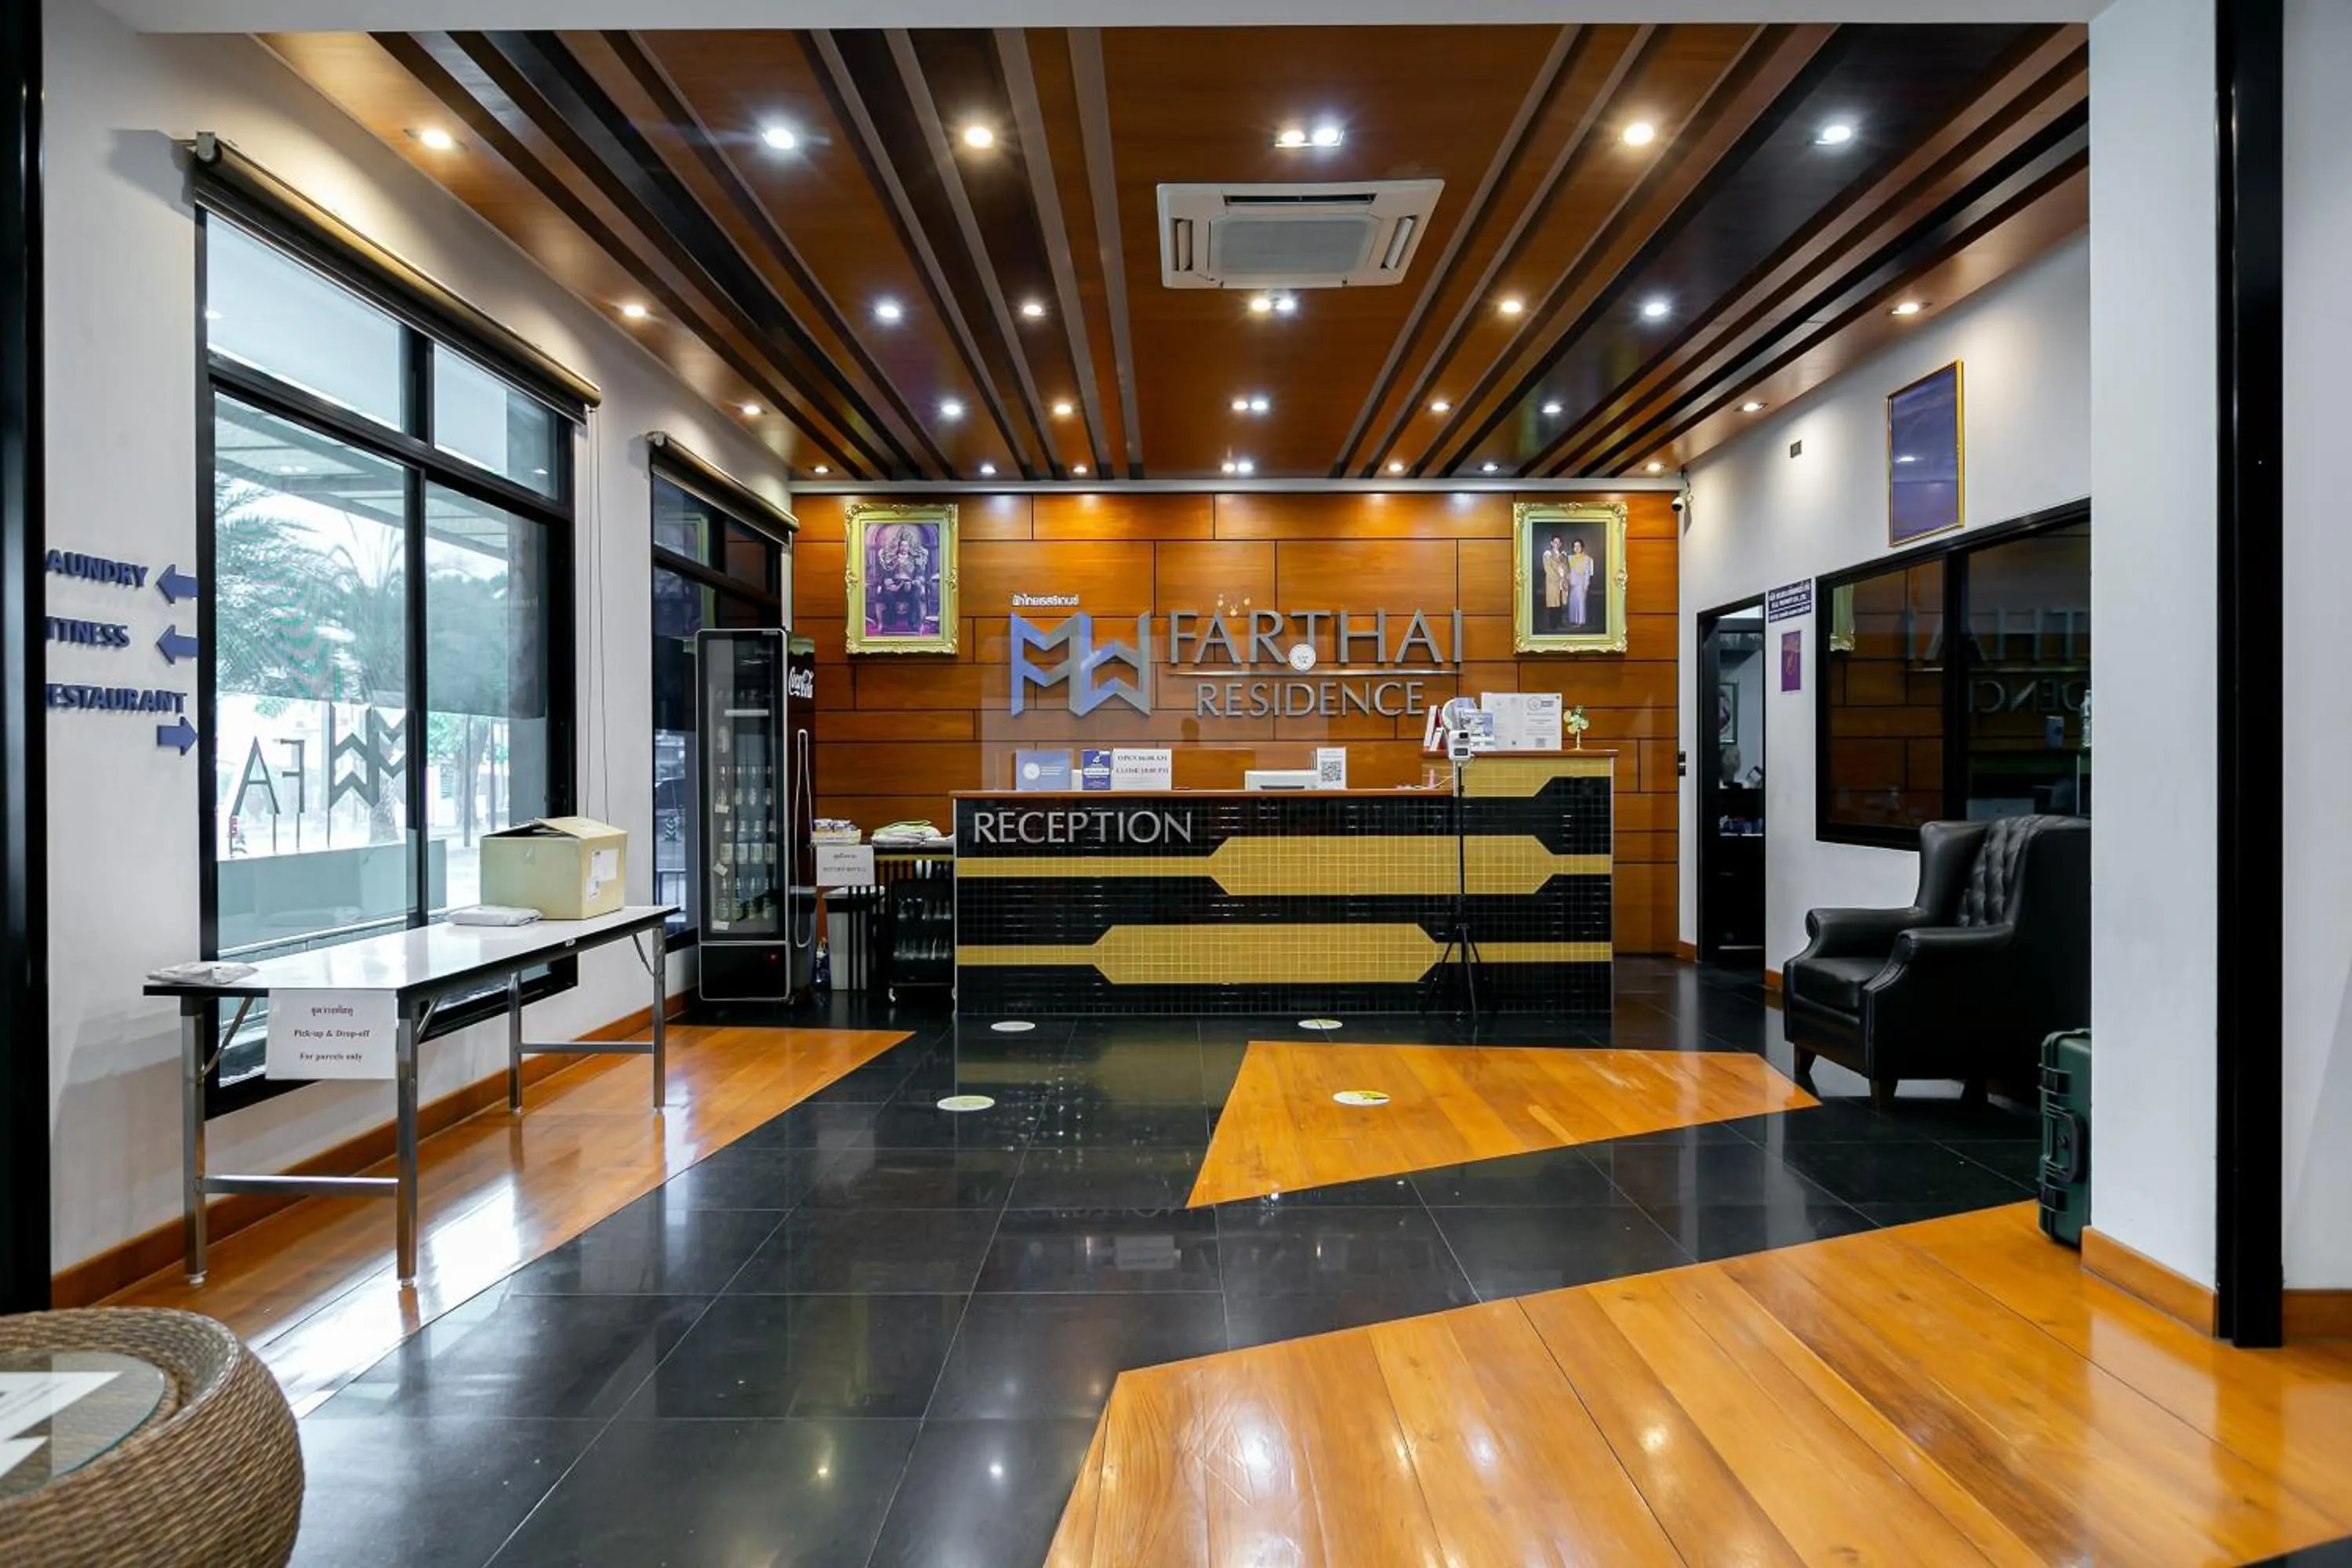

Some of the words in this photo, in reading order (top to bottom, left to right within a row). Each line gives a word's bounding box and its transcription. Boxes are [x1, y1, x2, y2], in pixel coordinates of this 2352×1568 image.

[1169, 609, 1462, 664] FARTHAI
[1196, 681, 1425, 717] RESIDENCE
[974, 811, 1192, 844] RECEPTION
[294, 1029, 324, 1039] Pick-up
[326, 1029, 333, 1037] &
[336, 1029, 371, 1039] Drop-off
